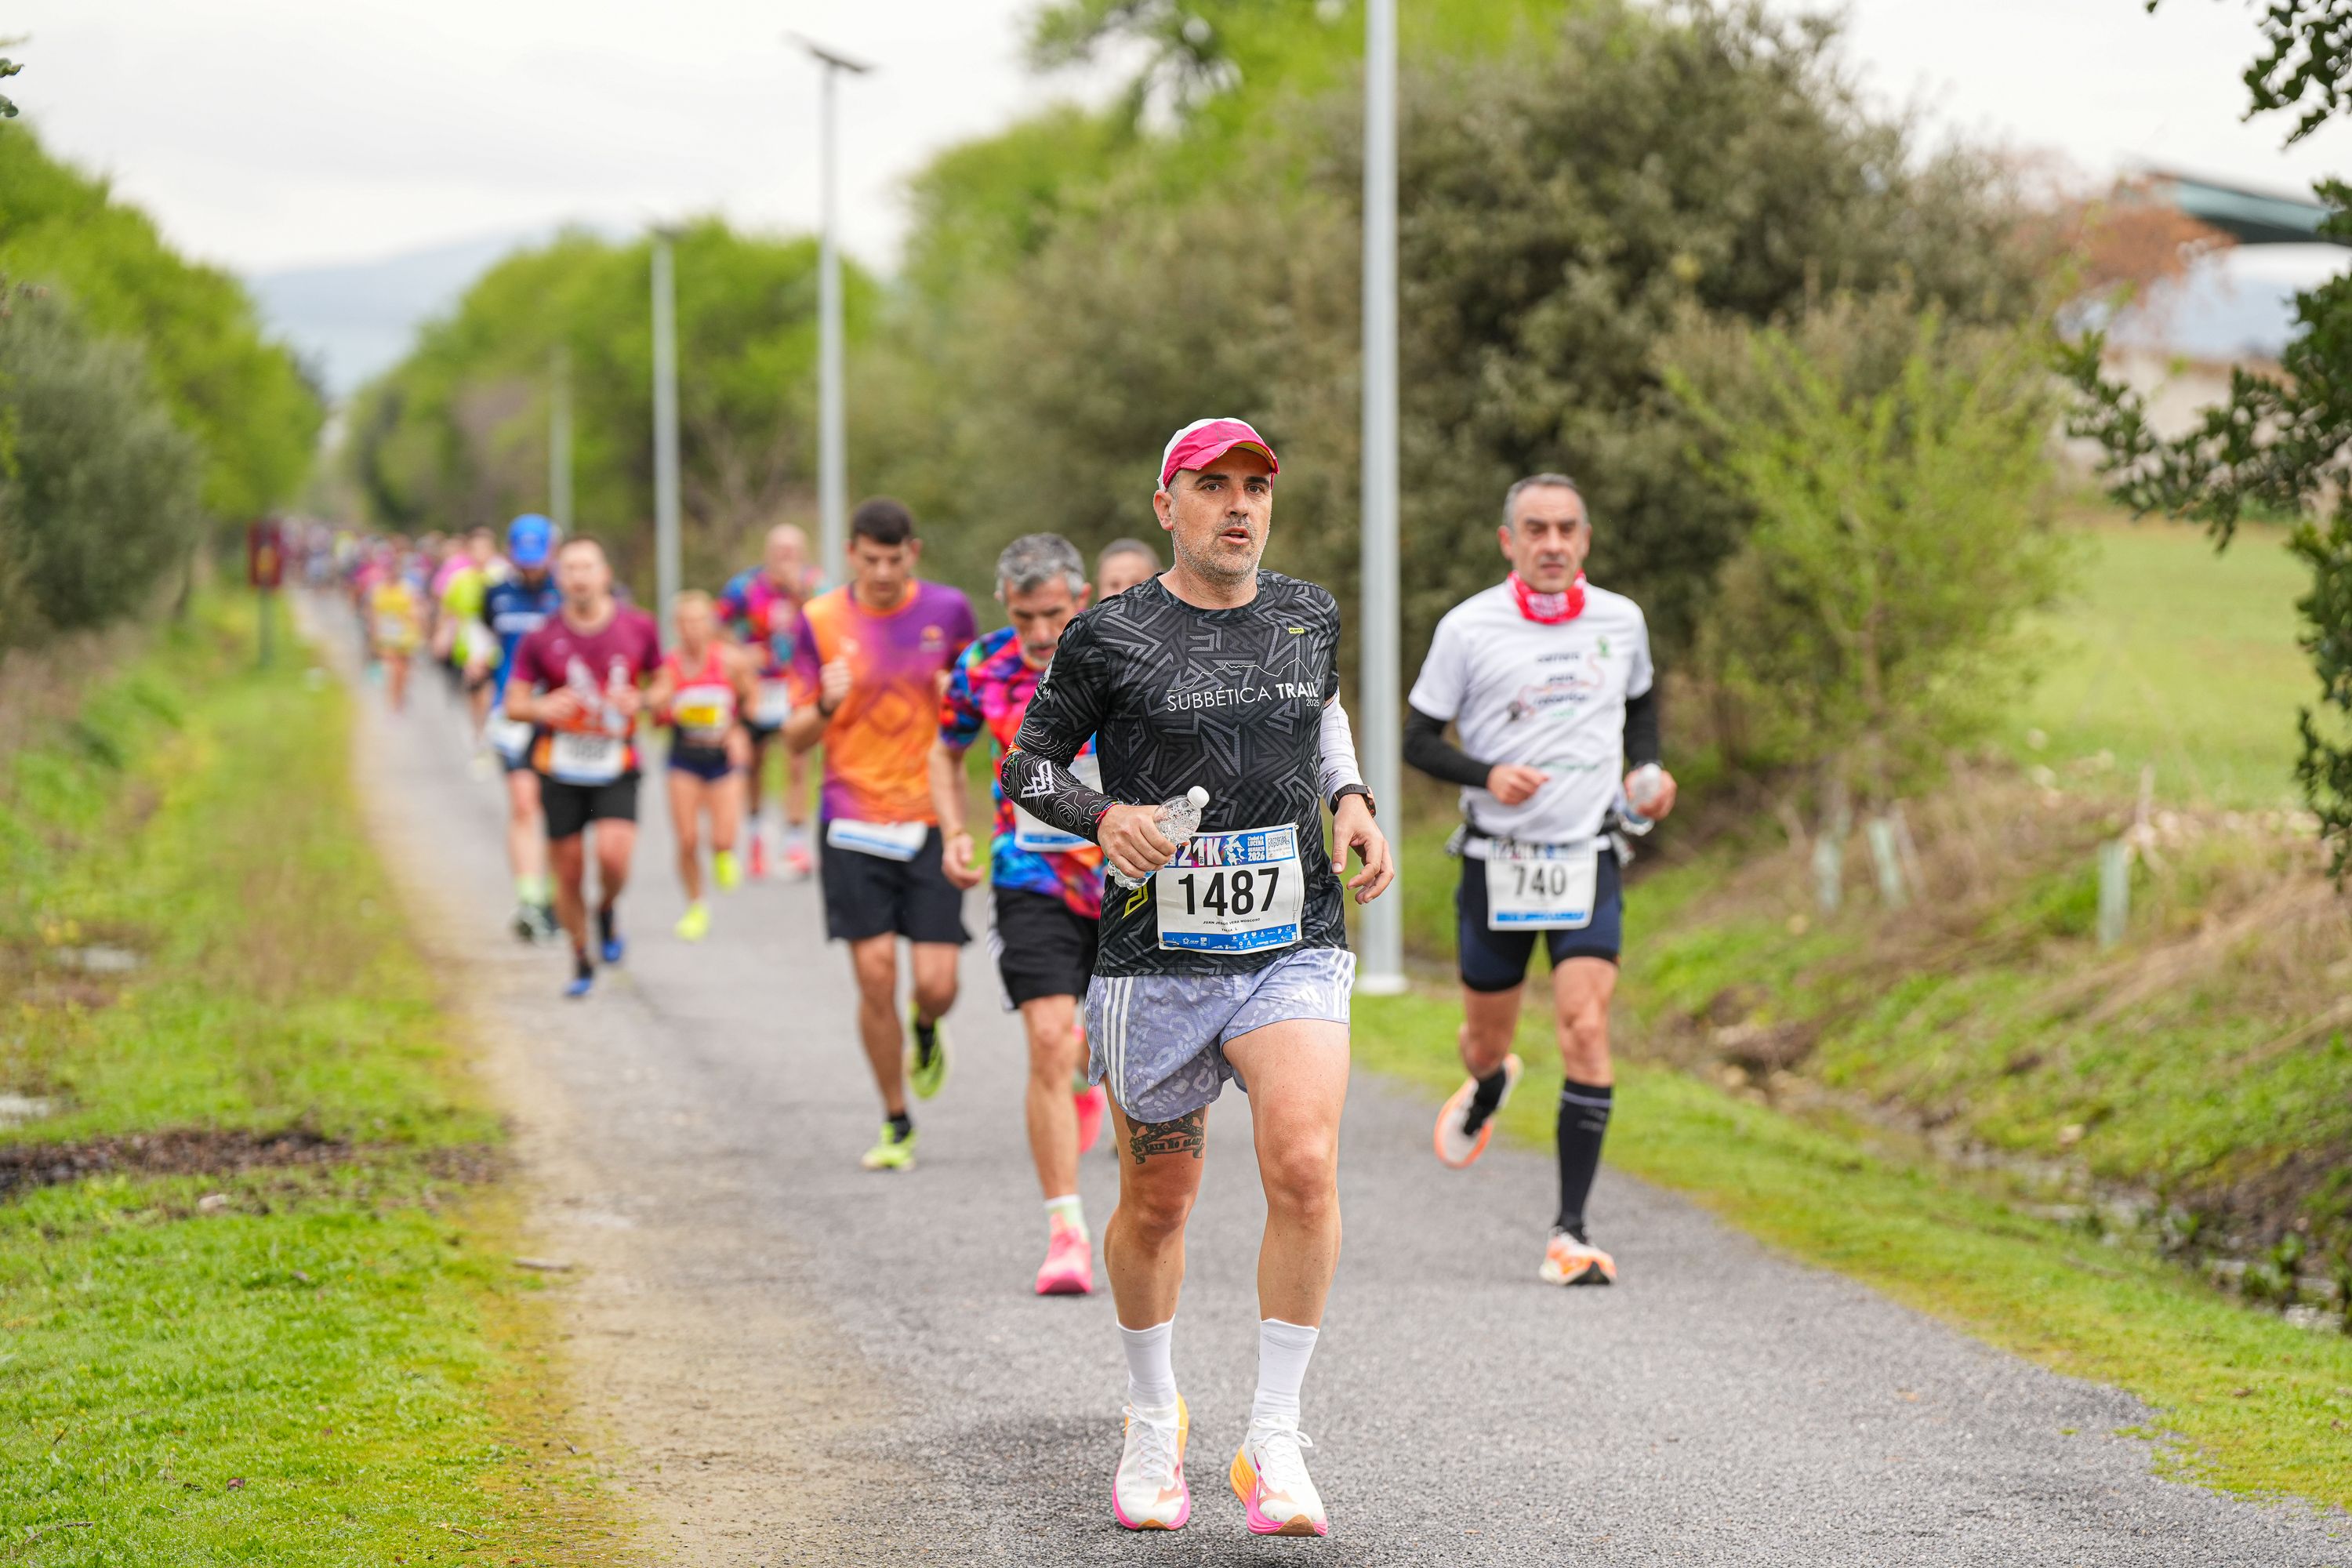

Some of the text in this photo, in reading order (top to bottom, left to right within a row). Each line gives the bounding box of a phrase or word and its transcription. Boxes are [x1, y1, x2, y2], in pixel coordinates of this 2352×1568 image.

[1167, 681, 1319, 712] SUBBÉTICA TRAIL
[1178, 837, 1223, 866] 21K
[1247, 851, 1265, 862] 2026
[1178, 866, 1279, 916] 1487
[1512, 864, 1567, 896] 740
